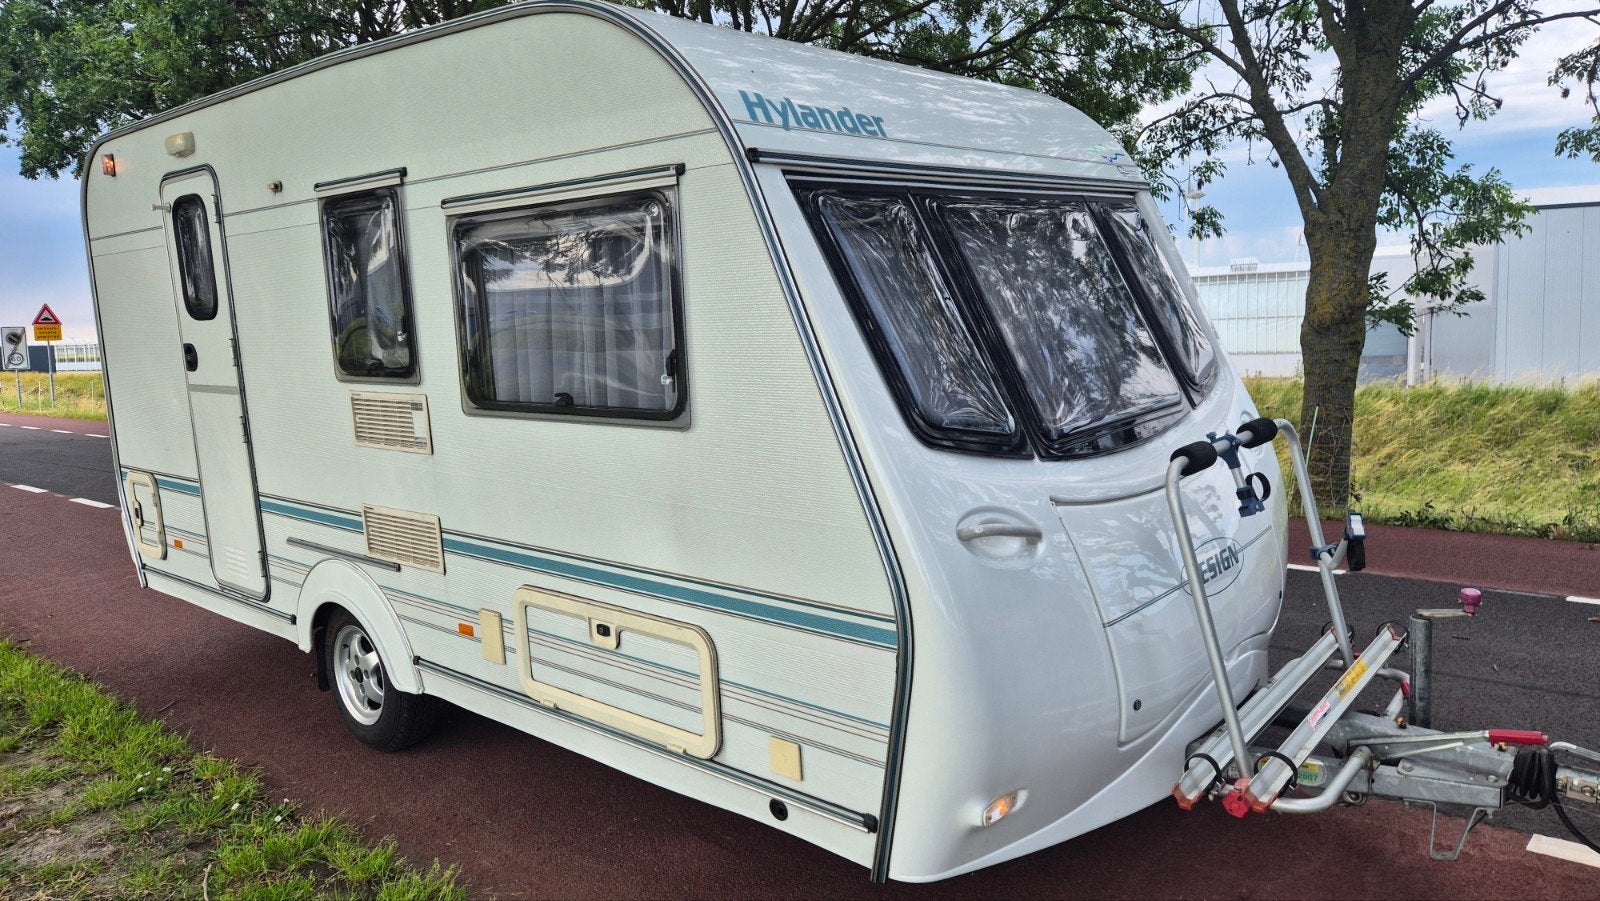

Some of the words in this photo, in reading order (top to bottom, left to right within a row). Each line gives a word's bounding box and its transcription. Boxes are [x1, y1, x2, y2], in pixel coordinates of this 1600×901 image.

[738, 89, 888, 138] Hylander
[1198, 542, 1239, 584] ESIGN
[1298, 772, 1318, 782] 2007
